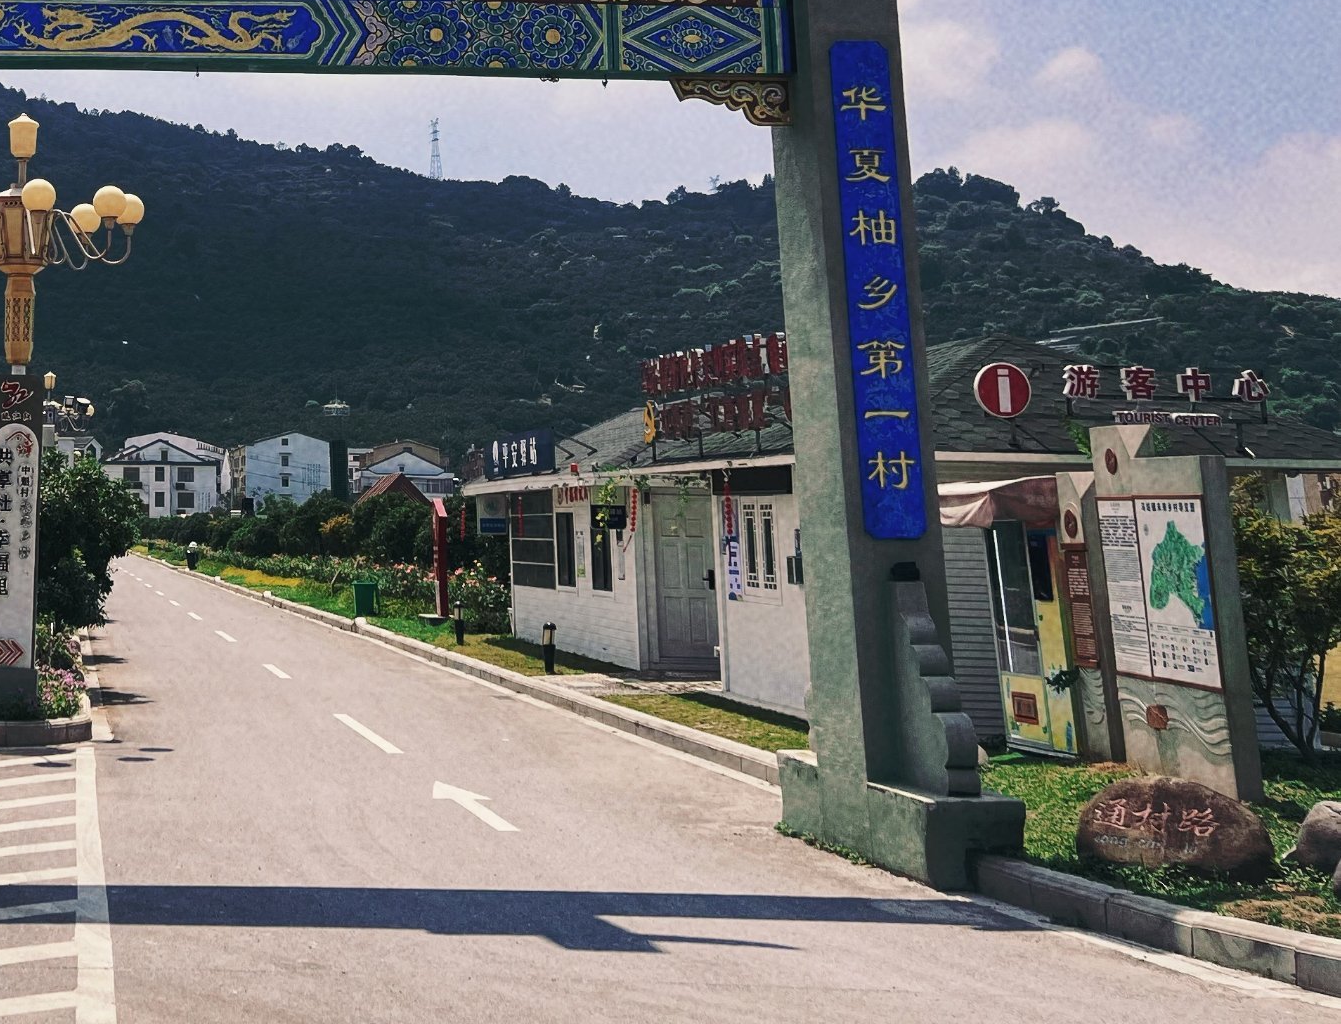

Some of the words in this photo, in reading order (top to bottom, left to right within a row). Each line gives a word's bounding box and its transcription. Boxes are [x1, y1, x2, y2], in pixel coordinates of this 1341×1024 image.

[840, 85, 915, 490] 华夏柚乡第一村
[1062, 364, 1271, 403] 游客中心
[1115, 411, 1171, 424] TOURIST
[1173, 414, 1222, 426] CENTER
